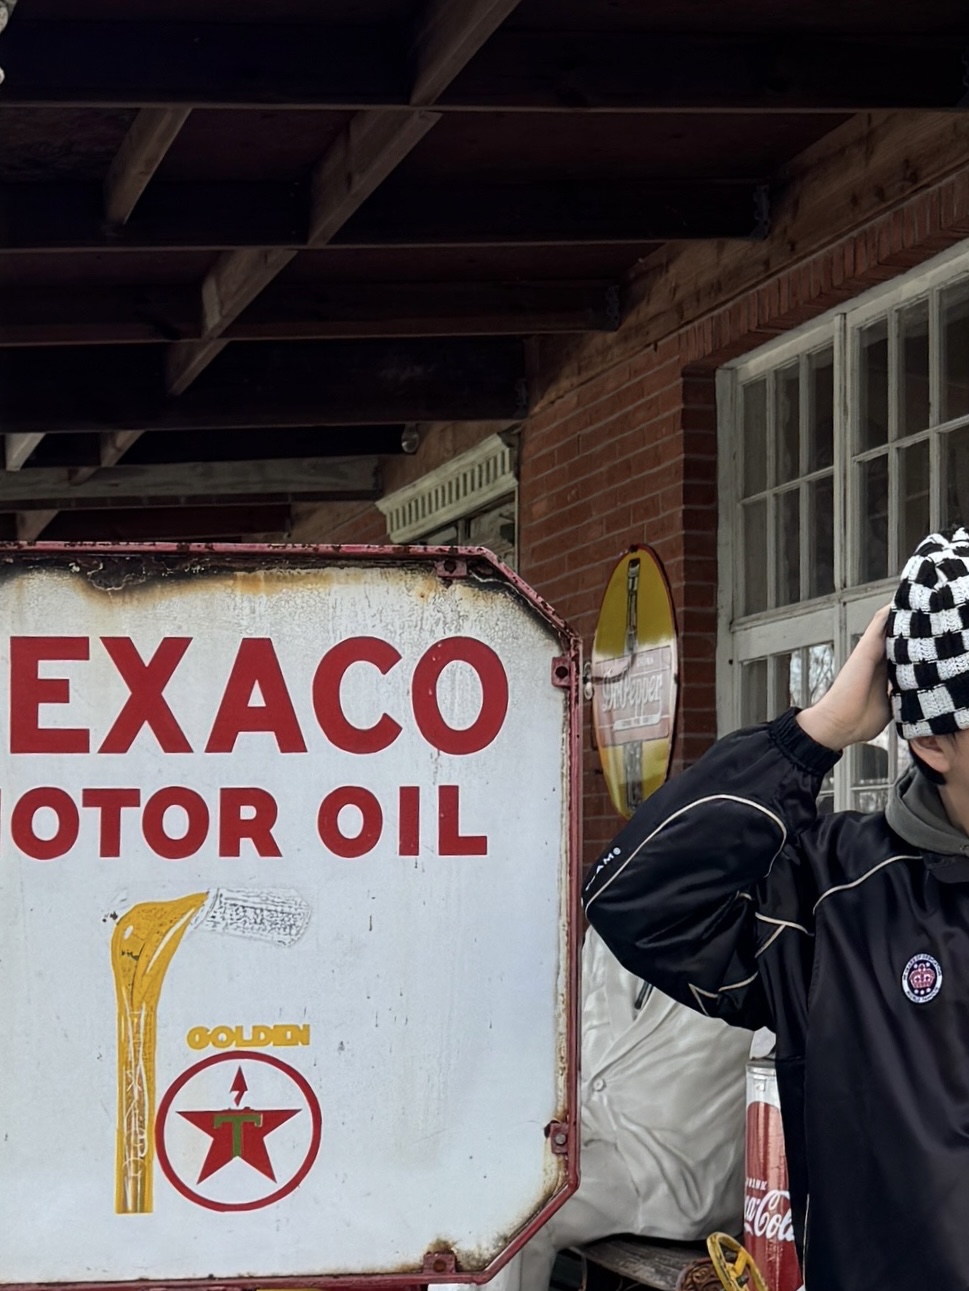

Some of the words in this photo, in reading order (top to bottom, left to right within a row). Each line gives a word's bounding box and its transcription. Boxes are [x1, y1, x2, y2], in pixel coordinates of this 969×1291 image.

[0, 785, 283, 861] OTOR
[317, 785, 488, 858] OIL
[186, 1024, 311, 1050] GOLDEN
